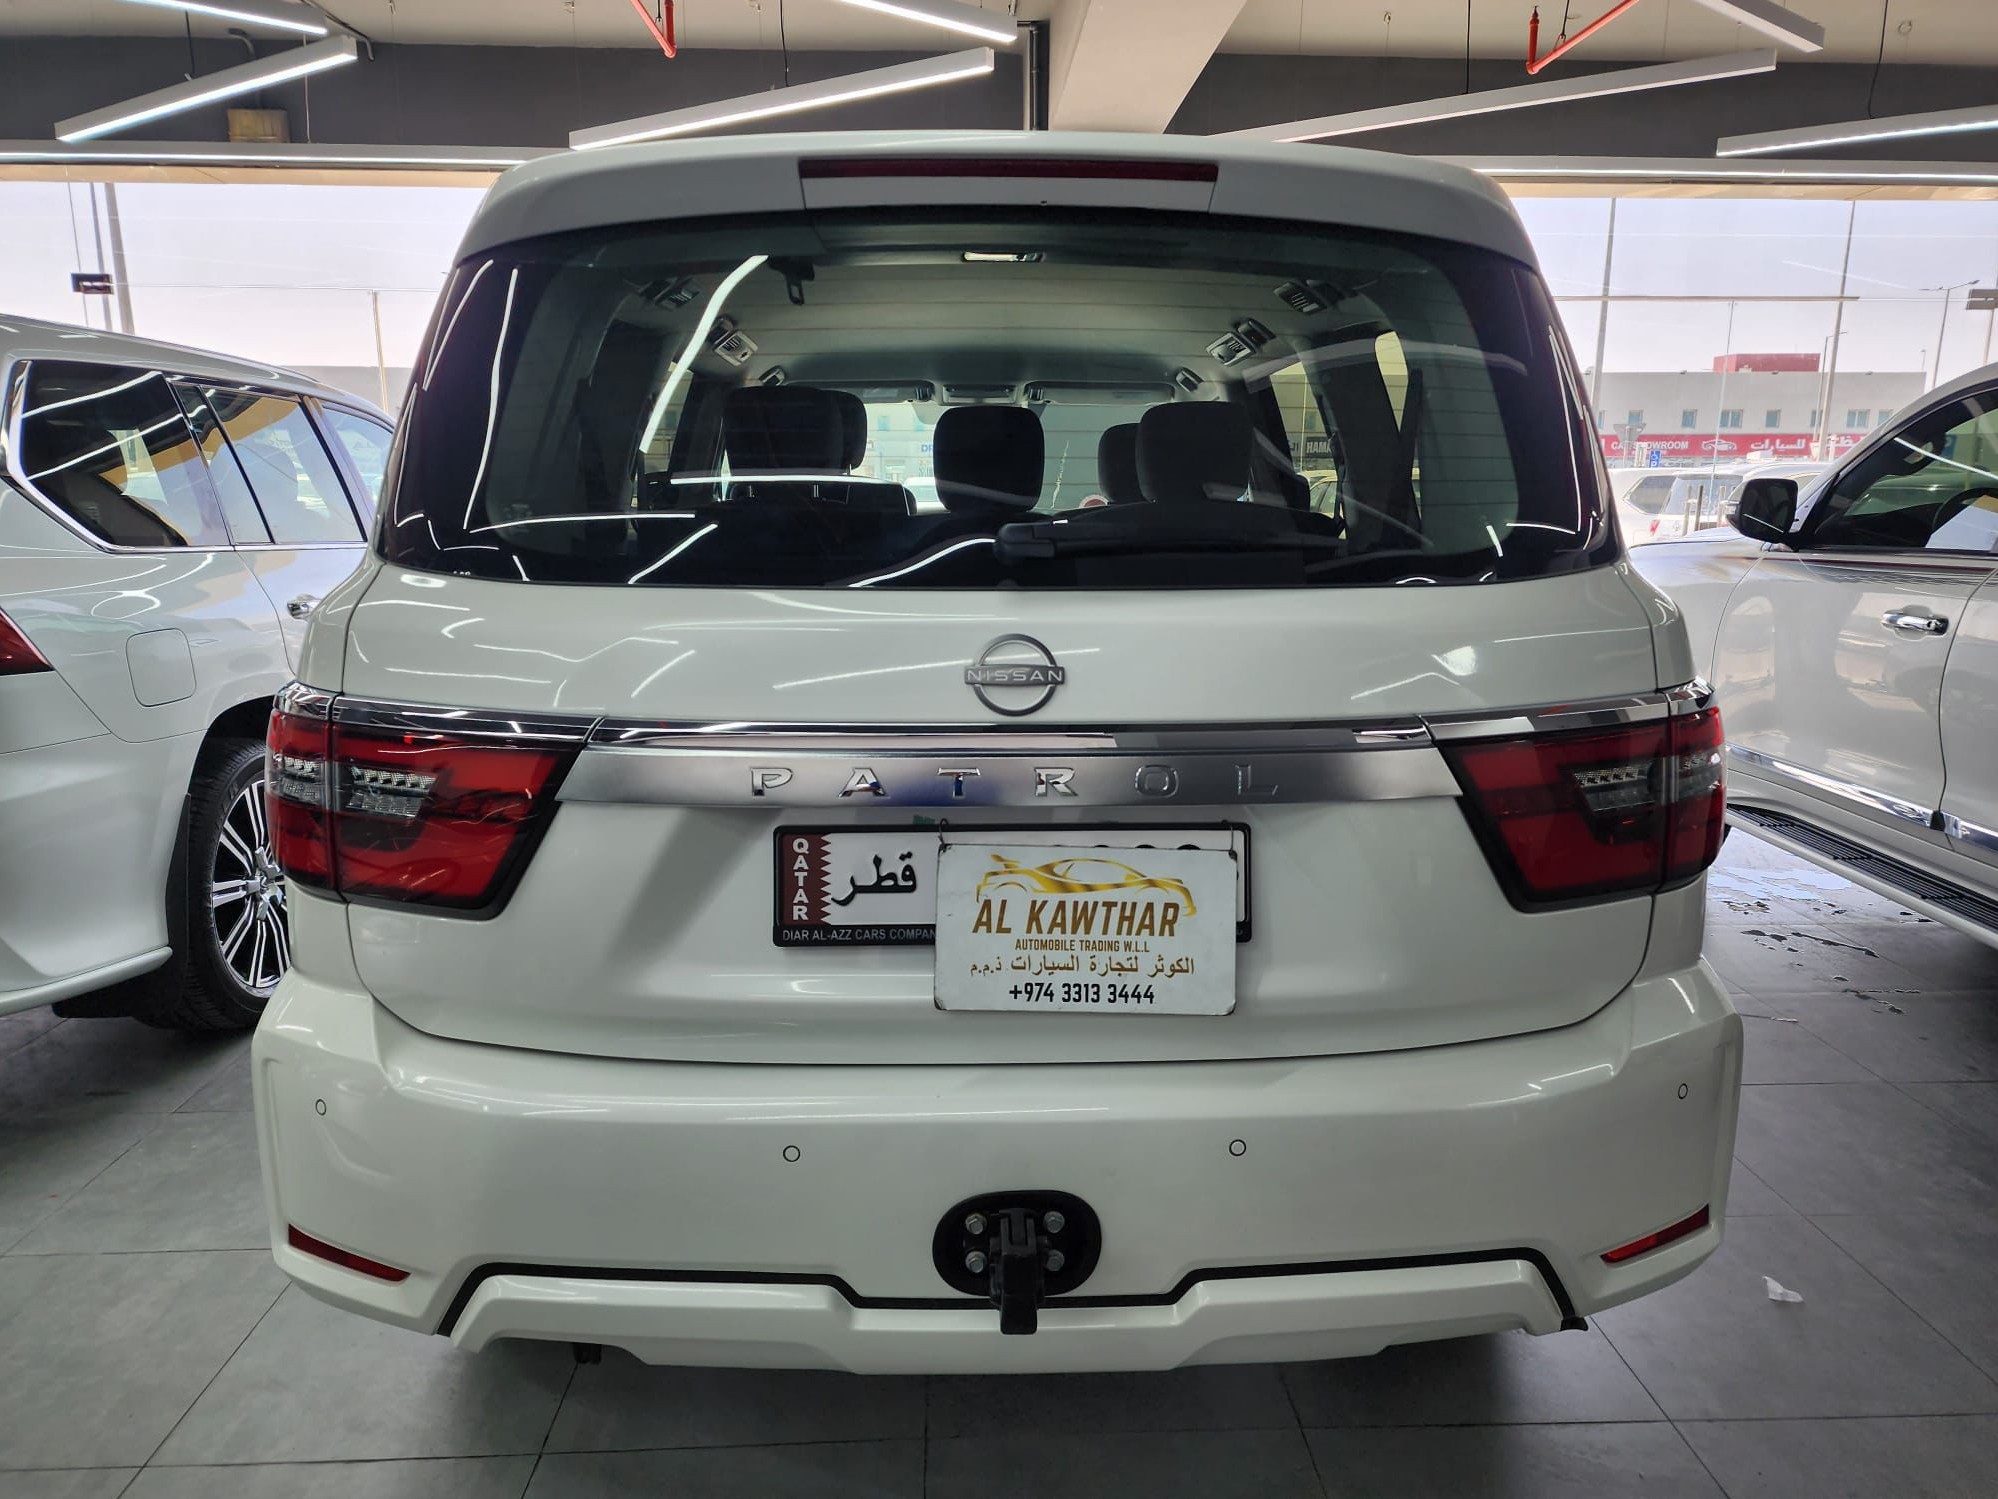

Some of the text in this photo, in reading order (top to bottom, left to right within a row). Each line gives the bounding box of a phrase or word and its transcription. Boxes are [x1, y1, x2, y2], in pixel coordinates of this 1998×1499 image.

[967, 668, 1063, 684] NISSAN
[750, 765, 1278, 798] PATROL
[792, 838, 809, 921] QATAR
[831, 851, 917, 907] قطر
[972, 898, 1180, 937] AL KAWTHAR
[782, 929, 810, 941] DIAR
[812, 929, 852, 941] AL-AZZ
[855, 928, 887, 940] CARS
[1014, 938, 1150, 953] AUTOMOBILE TRADING W.L.L
[1010, 955, 1080, 976] السيارات
[1089, 955, 1139, 976] لتجارة
[1147, 956, 1195, 978] الكوثر
[1009, 982, 1156, 1005] +974 3313 3444
